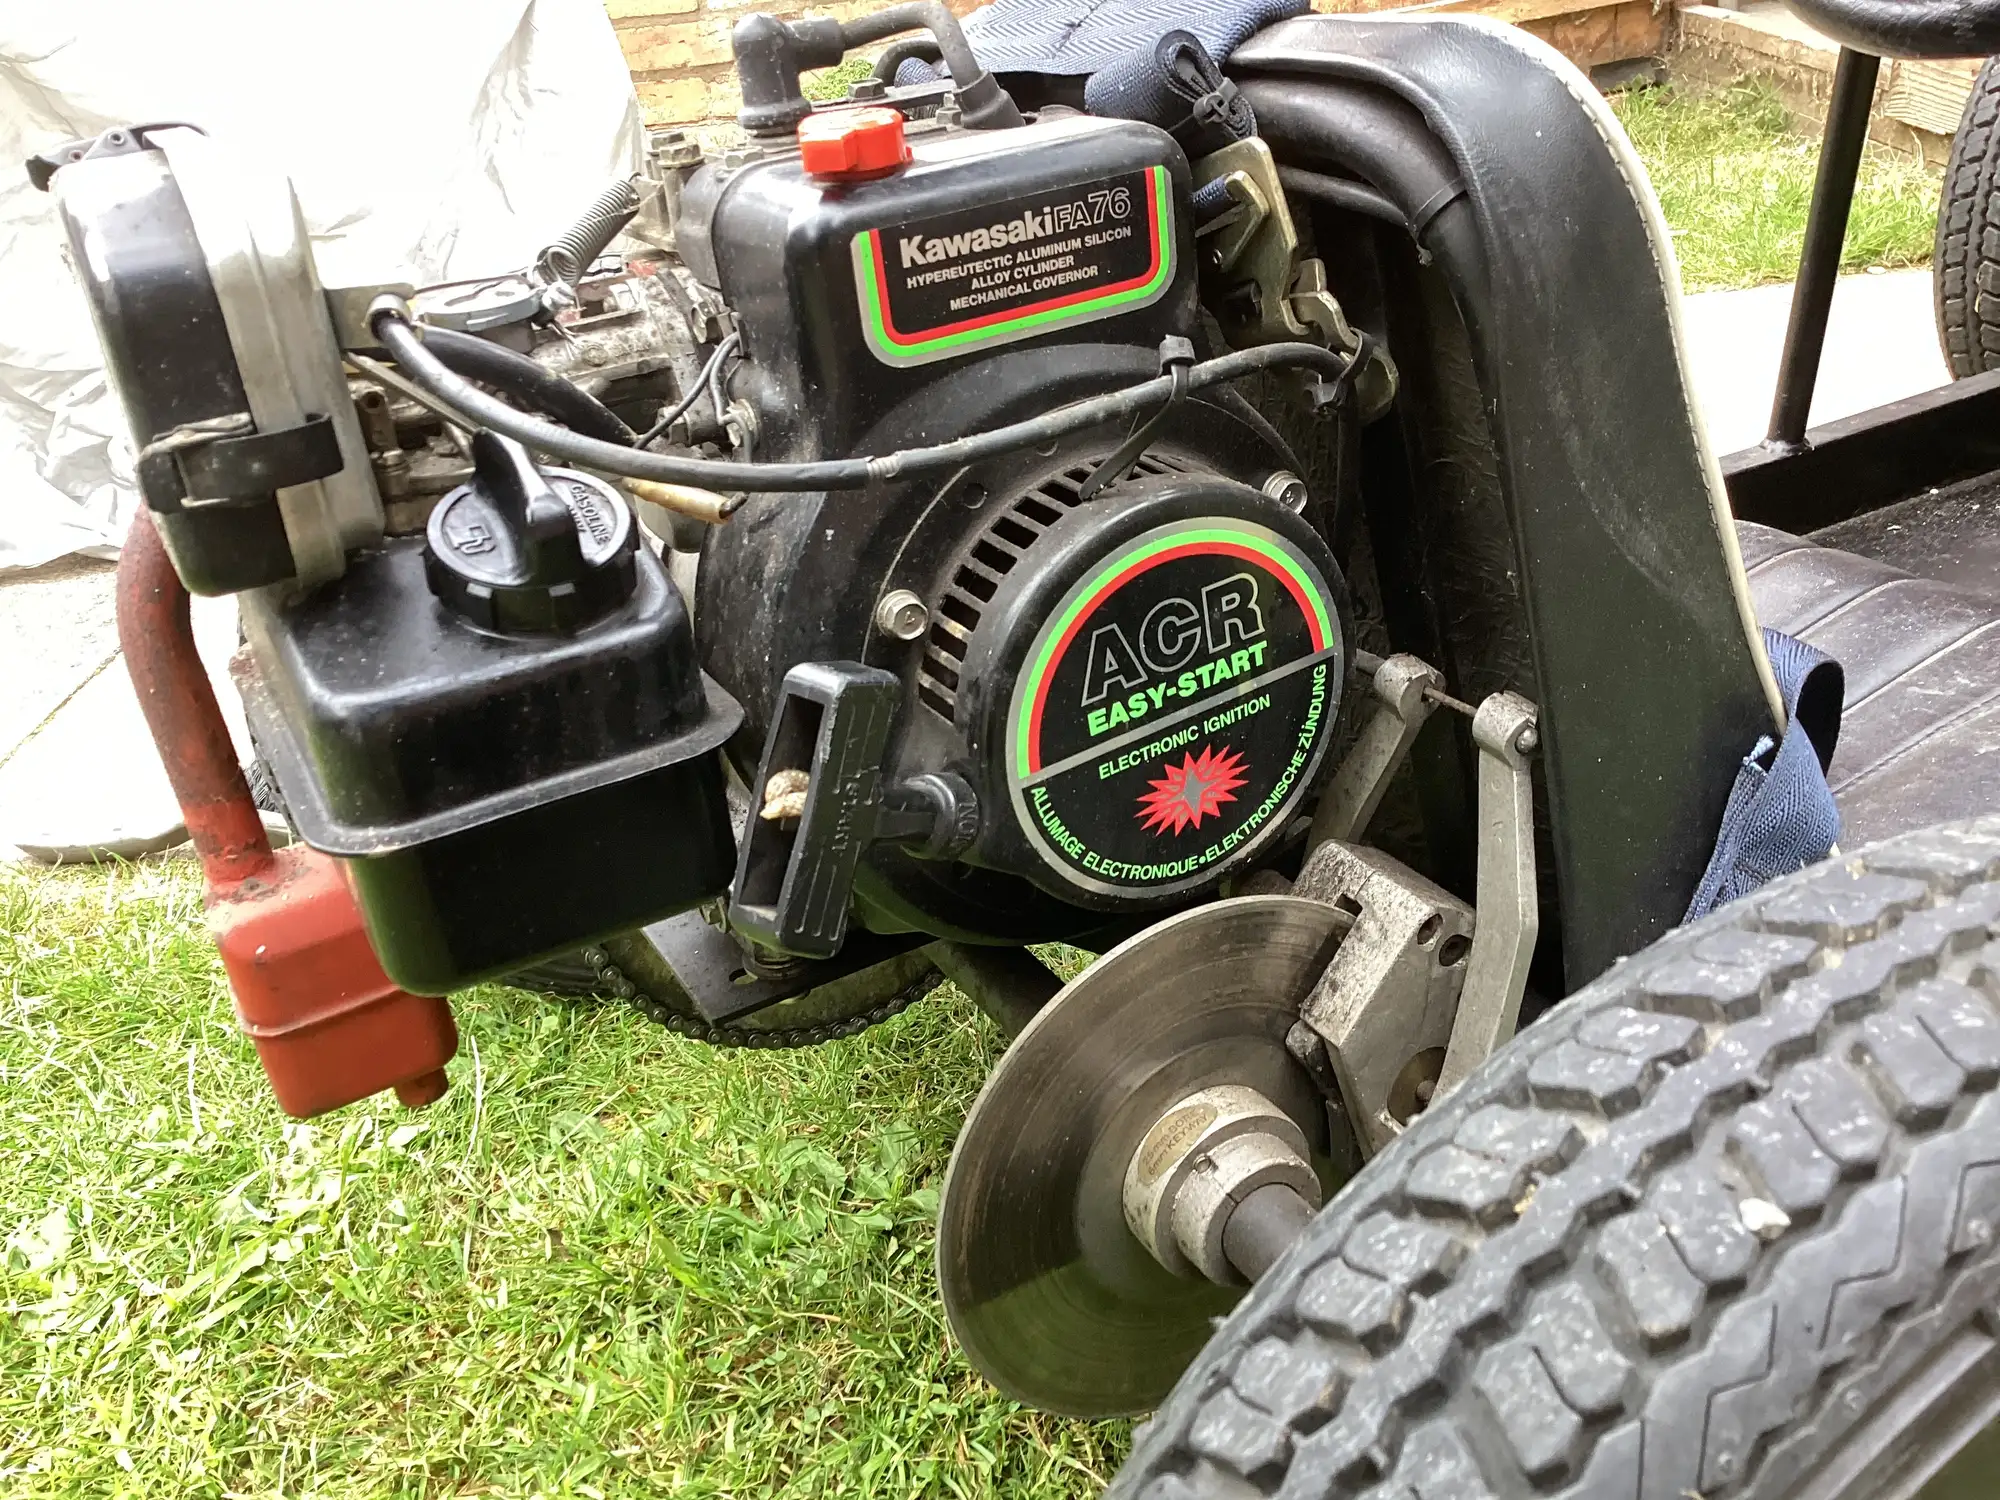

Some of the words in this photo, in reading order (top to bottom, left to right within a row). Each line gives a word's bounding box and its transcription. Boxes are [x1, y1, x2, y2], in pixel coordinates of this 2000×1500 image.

[900, 207, 1053, 268] Kawasaki
[1054, 187, 1132, 233] FA76
[907, 255, 1013, 289] HYPEREUTECTIC
[1016, 238, 1082, 264] ALUMINUM
[1084, 225, 1132, 248] SILICON
[950, 282, 1032, 311] MECHANICAL
[1033, 265, 1099, 291] GOVERNOR
[971, 269, 1013, 291] ALLOY
[1014, 255, 1075, 280] CYLINDER
[571, 484, 611, 545] GASOLINE
[1081, 573, 1265, 707] ACR
[1087, 641, 1268, 736] EASY-START
[1098, 725, 1199, 780] ELECTRONIC
[1203, 693, 1271, 735] IGNITION
[1031, 785, 1085, 860] ALLUMAGE
[1082, 851, 1199, 881] ELECTRONIQUE
[1204, 752, 1306, 863] ELEKTRONISCHE
[1298, 664, 1327, 749] ZÜNDUNG
[1143, 1134, 1170, 1166] 25mm
[1148, 1149, 1169, 1175] 6mm
[1165, 1112, 1208, 1150] KEYWAY
